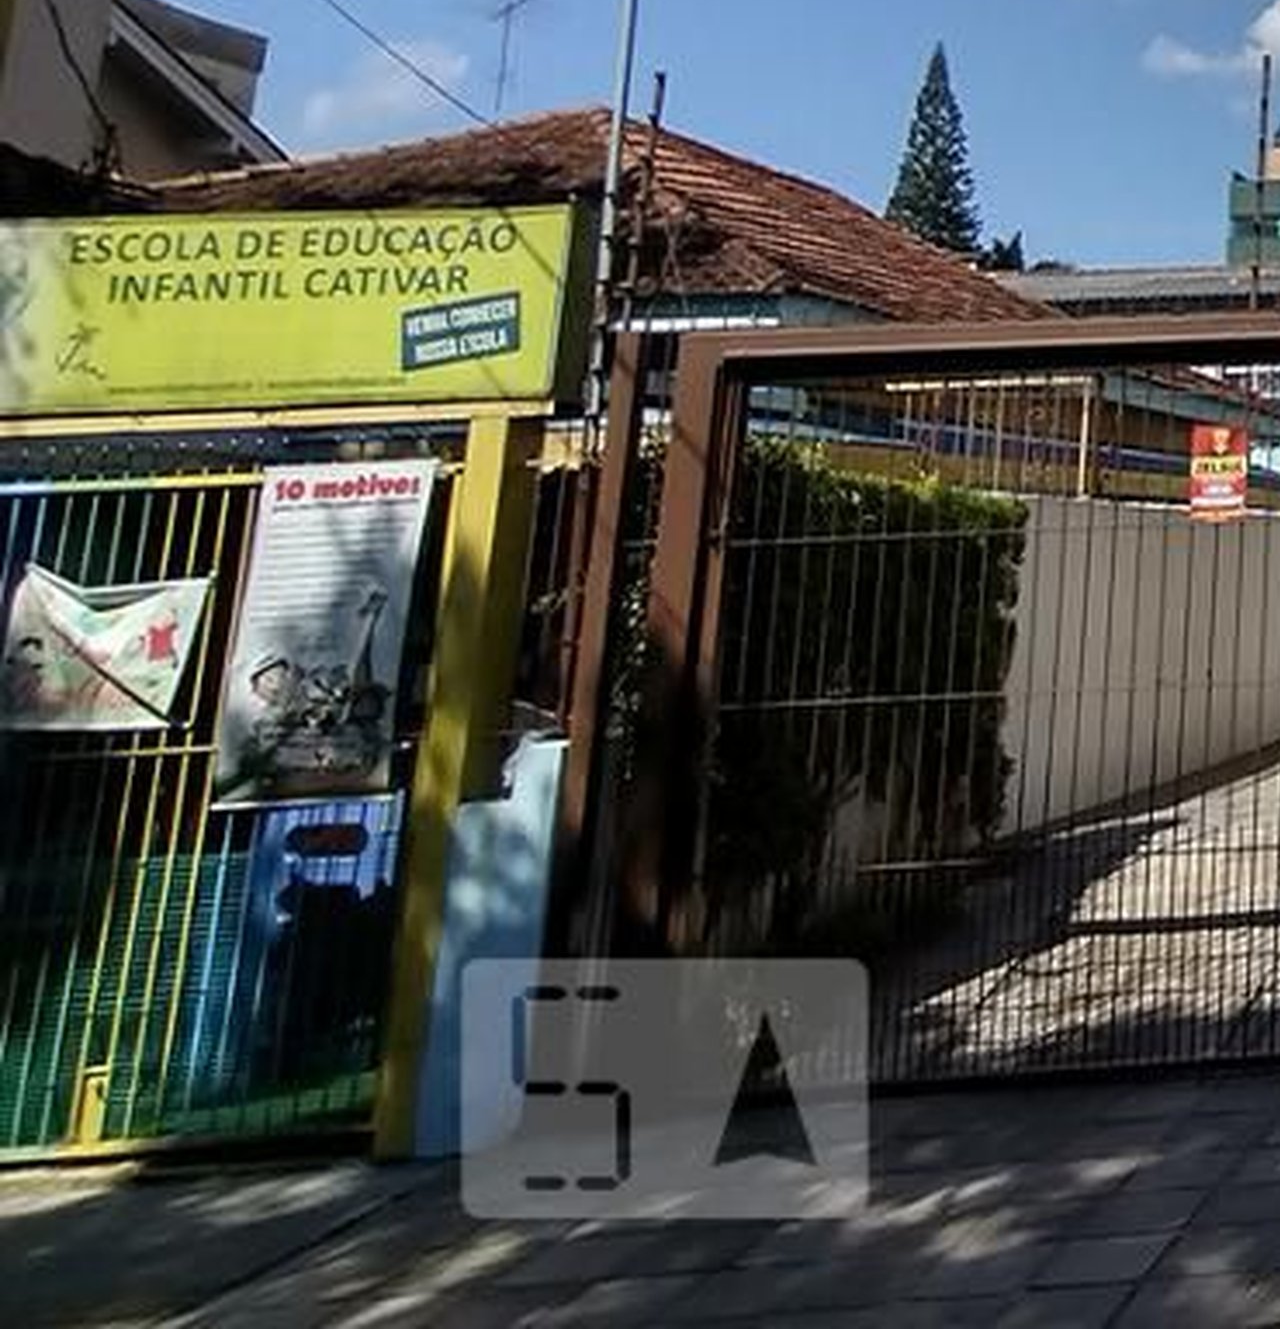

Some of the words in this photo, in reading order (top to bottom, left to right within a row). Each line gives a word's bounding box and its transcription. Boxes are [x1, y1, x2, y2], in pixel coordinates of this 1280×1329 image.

[69, 230, 221, 265] ESCOLA
[236, 229, 287, 260] DE
[299, 218, 518, 261] EDUCAÇÃO
[107, 271, 290, 304] INFANTIL
[304, 266, 469, 299] CATIVAR
[274, 479, 305, 501] 10
[312, 473, 421, 499] motivos
